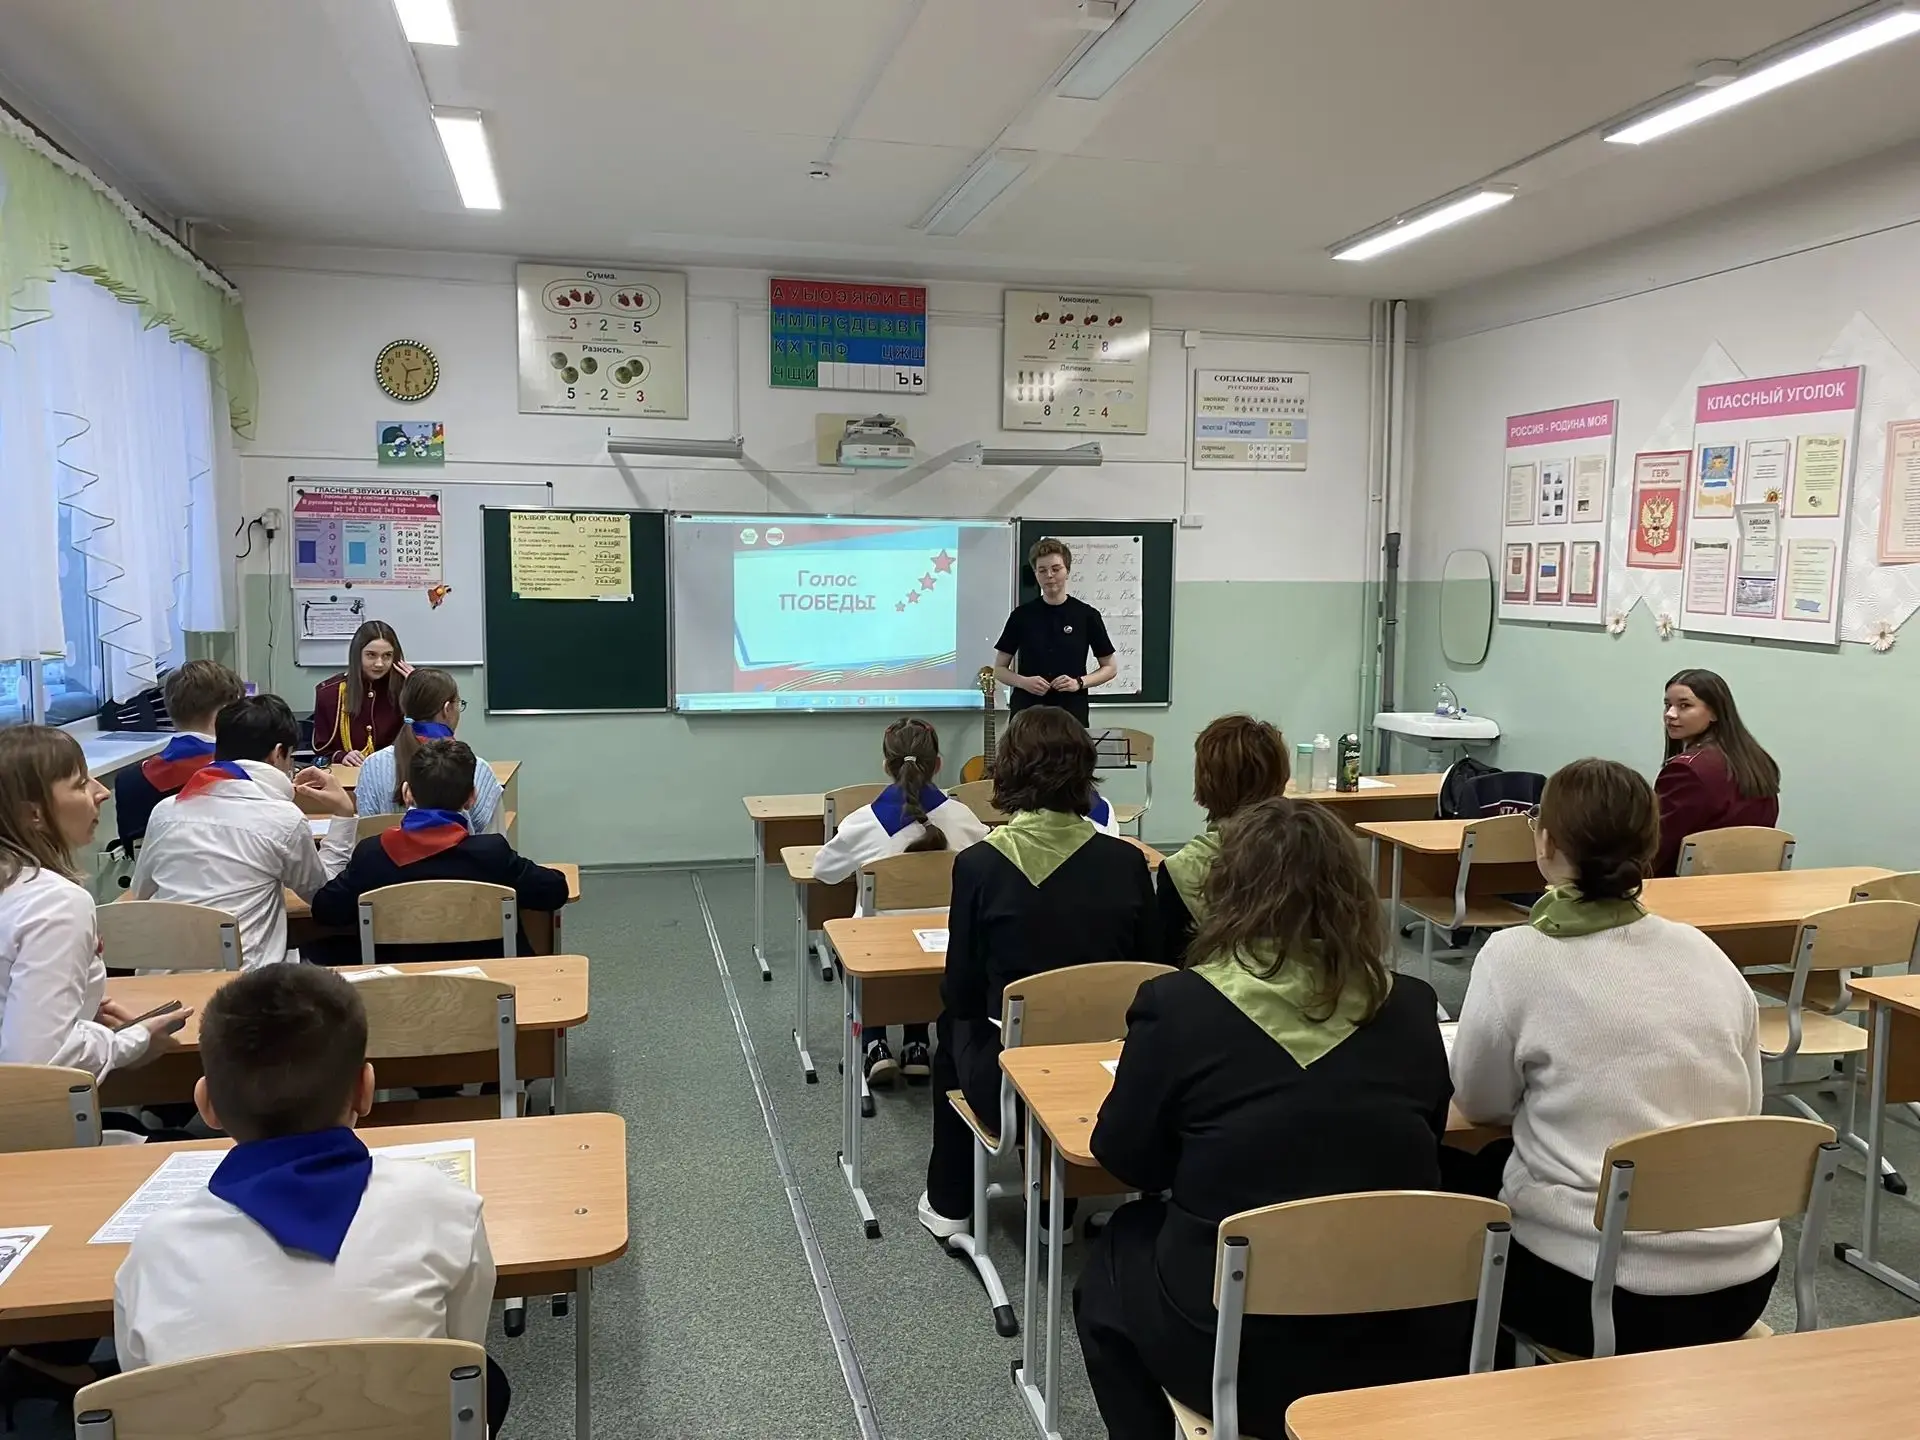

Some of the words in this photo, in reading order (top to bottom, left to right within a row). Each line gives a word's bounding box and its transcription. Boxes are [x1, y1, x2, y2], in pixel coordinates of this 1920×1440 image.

[586, 271, 617, 280] Сумма.
[569, 317, 577, 329] 3
[600, 319, 608, 331] 2
[633, 321, 641, 333] 5
[582, 345, 624, 354] Разность.
[1049, 339, 1056, 350] 2
[1072, 340, 1079, 351] 4
[1102, 341, 1108, 352] 8
[1214, 375, 1265, 383] СОГЛАСНЫЕ
[1267, 376, 1293, 384] ЗВУКИ
[567, 388, 575, 399] 5
[600, 388, 608, 400] 2
[636, 390, 644, 402] 3
[1707, 387, 1783, 411] КЛАССНЫЙ
[1787, 382, 1845, 401] УГОЛОК
[1044, 405, 1051, 416] 8
[1073, 406, 1080, 417] 2
[1101, 407, 1108, 417] 4
[1511, 423, 1544, 437] РОССИЯ
[1550, 418, 1586, 433] РОДИНА
[1587, 414, 1608, 428] МОЯ
[797, 570, 857, 587] Голос
[779, 593, 876, 613] ПОБЕДЫ
